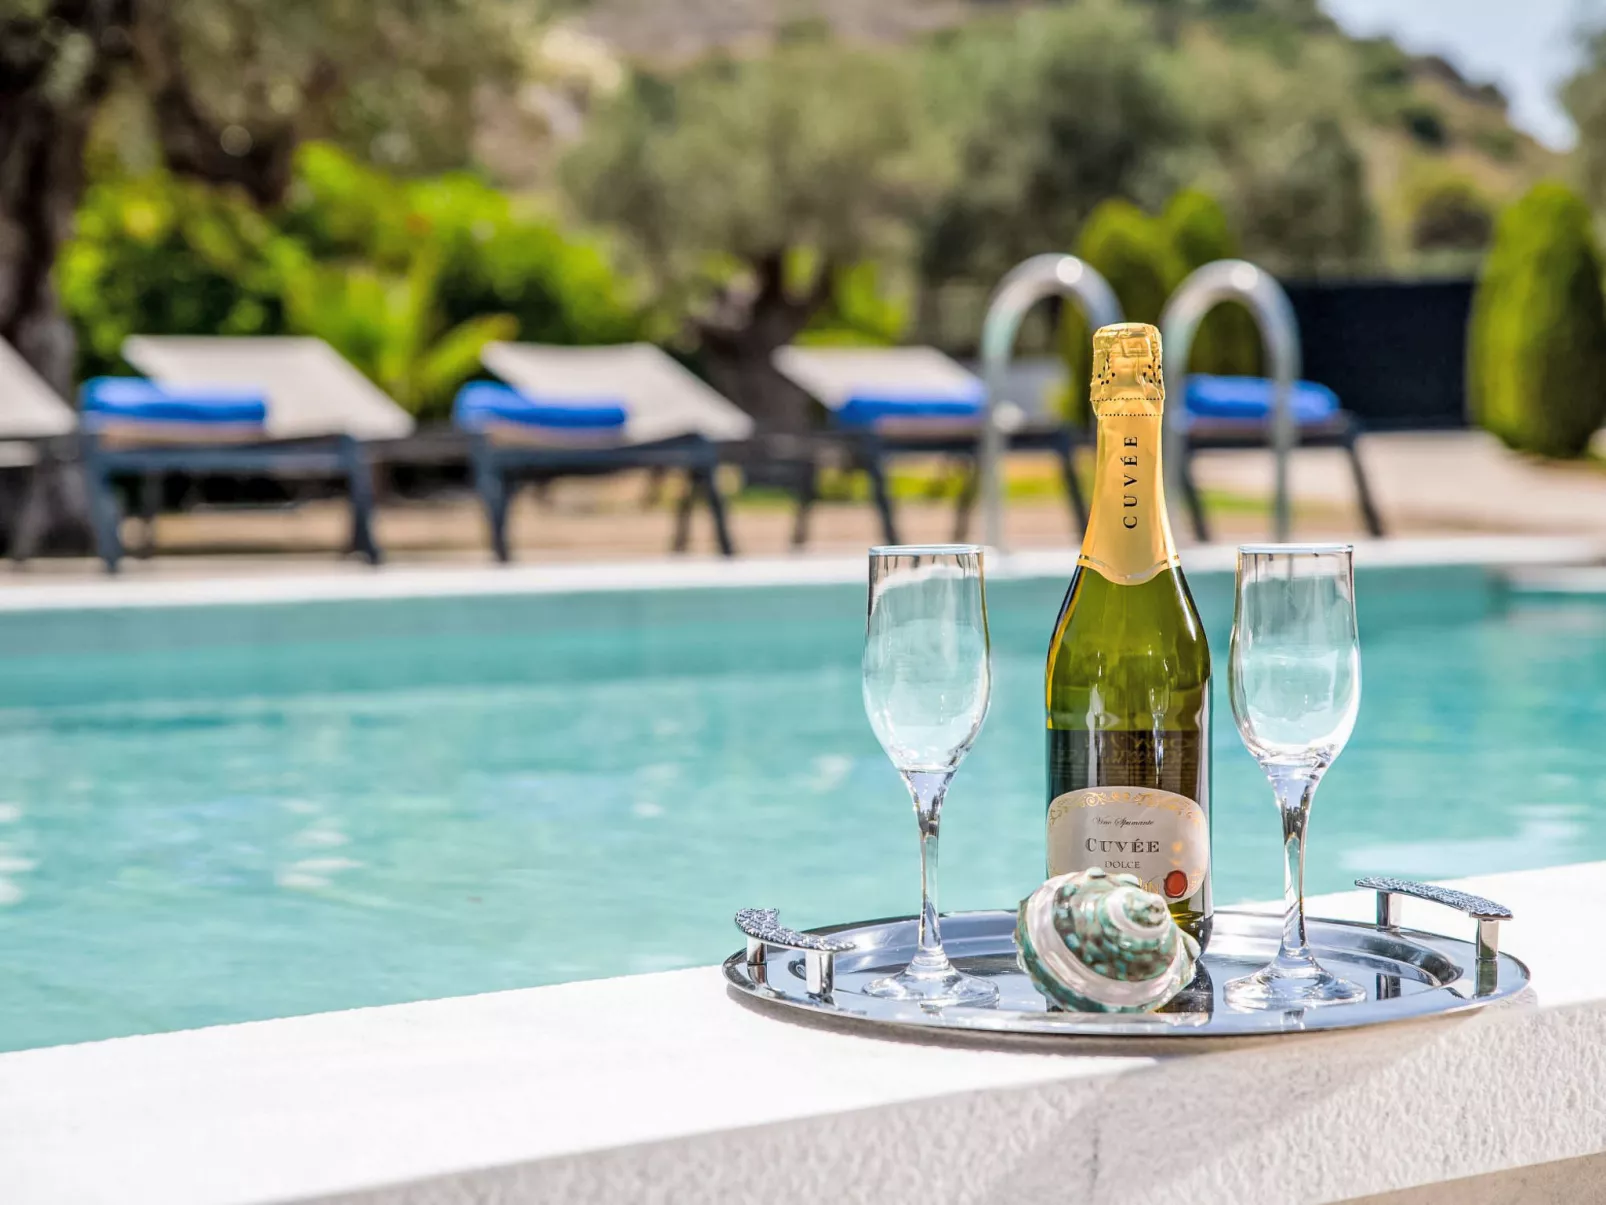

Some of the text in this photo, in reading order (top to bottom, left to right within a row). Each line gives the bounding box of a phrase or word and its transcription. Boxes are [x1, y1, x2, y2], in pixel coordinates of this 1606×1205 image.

[1120, 437, 1138, 529] CUVÉE
[1093, 817, 1155, 828] Vino Spumante
[1085, 838, 1160, 853] CUVÉE
[1105, 860, 1141, 869] DOLCE
